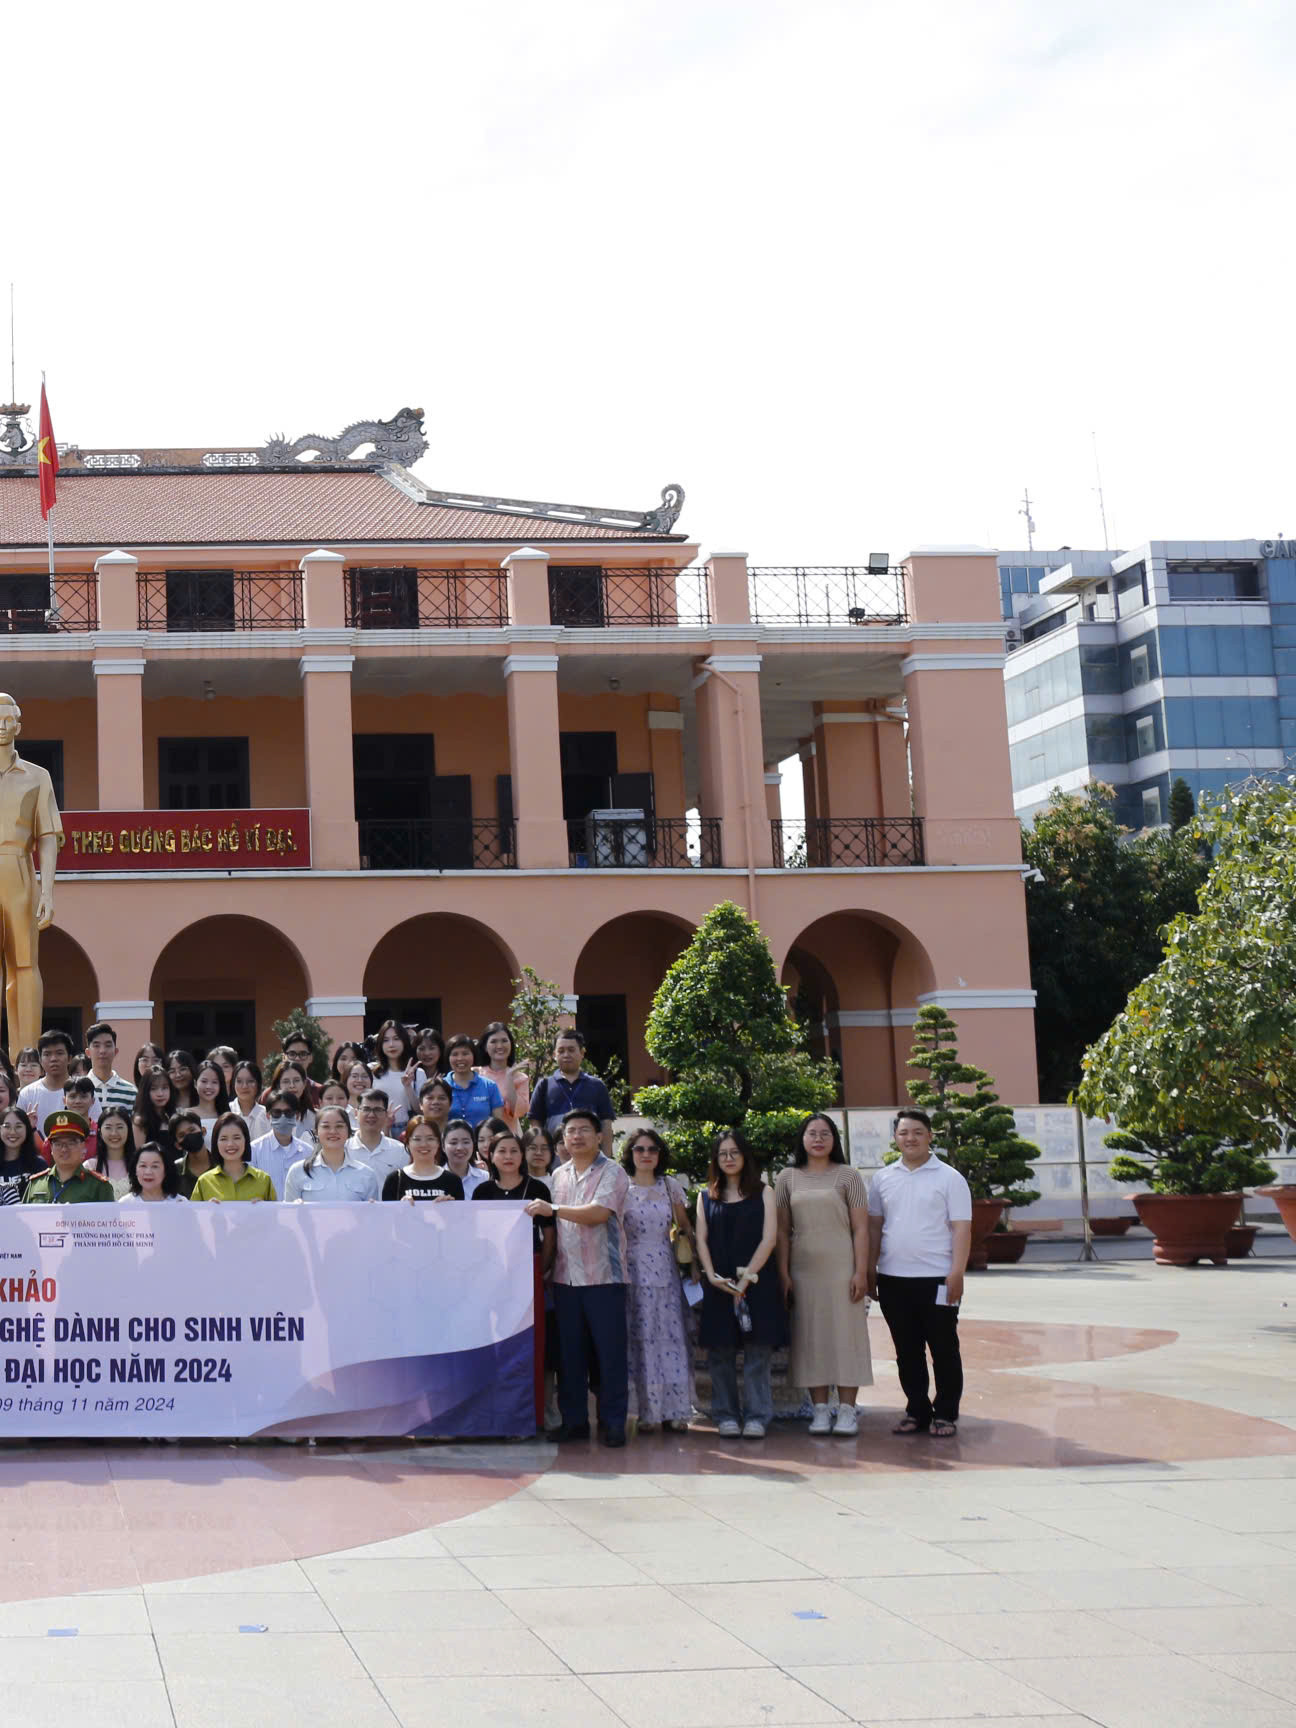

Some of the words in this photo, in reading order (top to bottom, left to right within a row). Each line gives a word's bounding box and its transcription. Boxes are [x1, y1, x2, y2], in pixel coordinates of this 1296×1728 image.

[71, 830, 114, 854] THEO
[180, 824, 213, 853] BÁC
[217, 819, 241, 852] HỒ
[54, 1312, 120, 1342] DÀNH
[128, 1317, 176, 1342] CHO
[184, 1316, 242, 1342] SINH
[249, 1311, 305, 1342] VIÊN
[4, 1358, 45, 1389] ĐẠI
[53, 1358, 101, 1389] HỌC
[109, 1352, 165, 1383] NĂM
[173, 1358, 232, 1383] 2024
[18, 1397, 64, 1415] tháng
[71, 1397, 88, 1412] 11
[94, 1397, 129, 1412] năm
[135, 1397, 175, 1412] 2024
